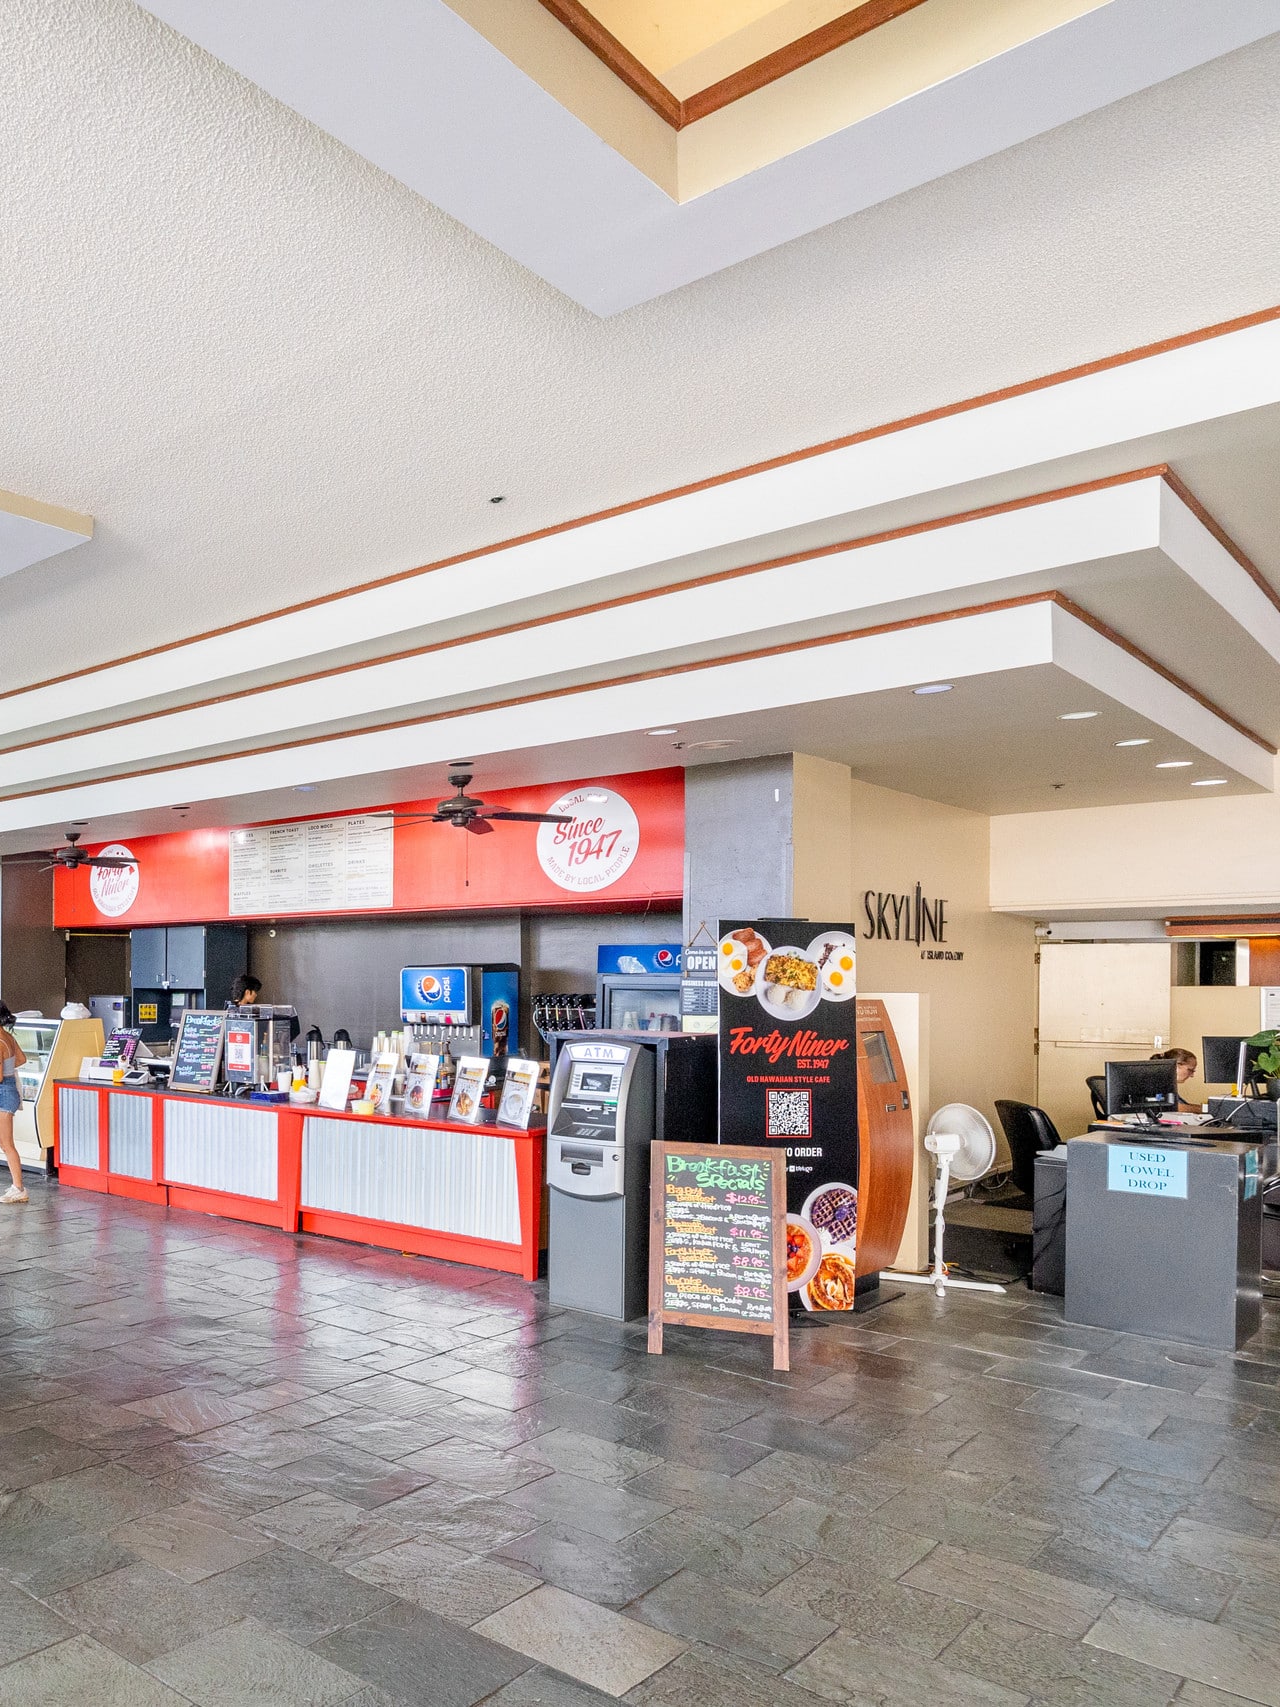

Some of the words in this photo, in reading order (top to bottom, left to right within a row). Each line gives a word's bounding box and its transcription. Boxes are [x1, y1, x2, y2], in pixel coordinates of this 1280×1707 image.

[553, 816, 606, 845] Since
[568, 829, 623, 867] 1947
[547, 856, 566, 878] MADE
[564, 873, 576, 884] BY
[577, 874, 605, 885] LOCAL
[605, 846, 630, 877] PEOPLE
[863, 881, 949, 947] SKYLINE
[687, 956, 716, 970] OPEN
[442, 976, 452, 1003] pepsi
[729, 1026, 790, 1064] Forty
[786, 1030, 850, 1057] Niner
[584, 1047, 614, 1059] ATM
[746, 1075, 759, 1083] OLD
[760, 1075, 793, 1083] HAWAIIAN
[794, 1075, 813, 1083] STYLE
[814, 1075, 830, 1083] CAFE
[785, 1147, 793, 1157] O
[794, 1147, 823, 1157] ORDER
[1129, 1151, 1166, 1163] USED
[666, 1155, 762, 1178] Breakfast
[1120, 1164, 1175, 1178] TOWEL
[1128, 1179, 1168, 1191] DROP
[729, 1227, 763, 1239] $11.95
[732, 1255, 765, 1268] $8.95
[734, 1284, 768, 1298] $8.95
